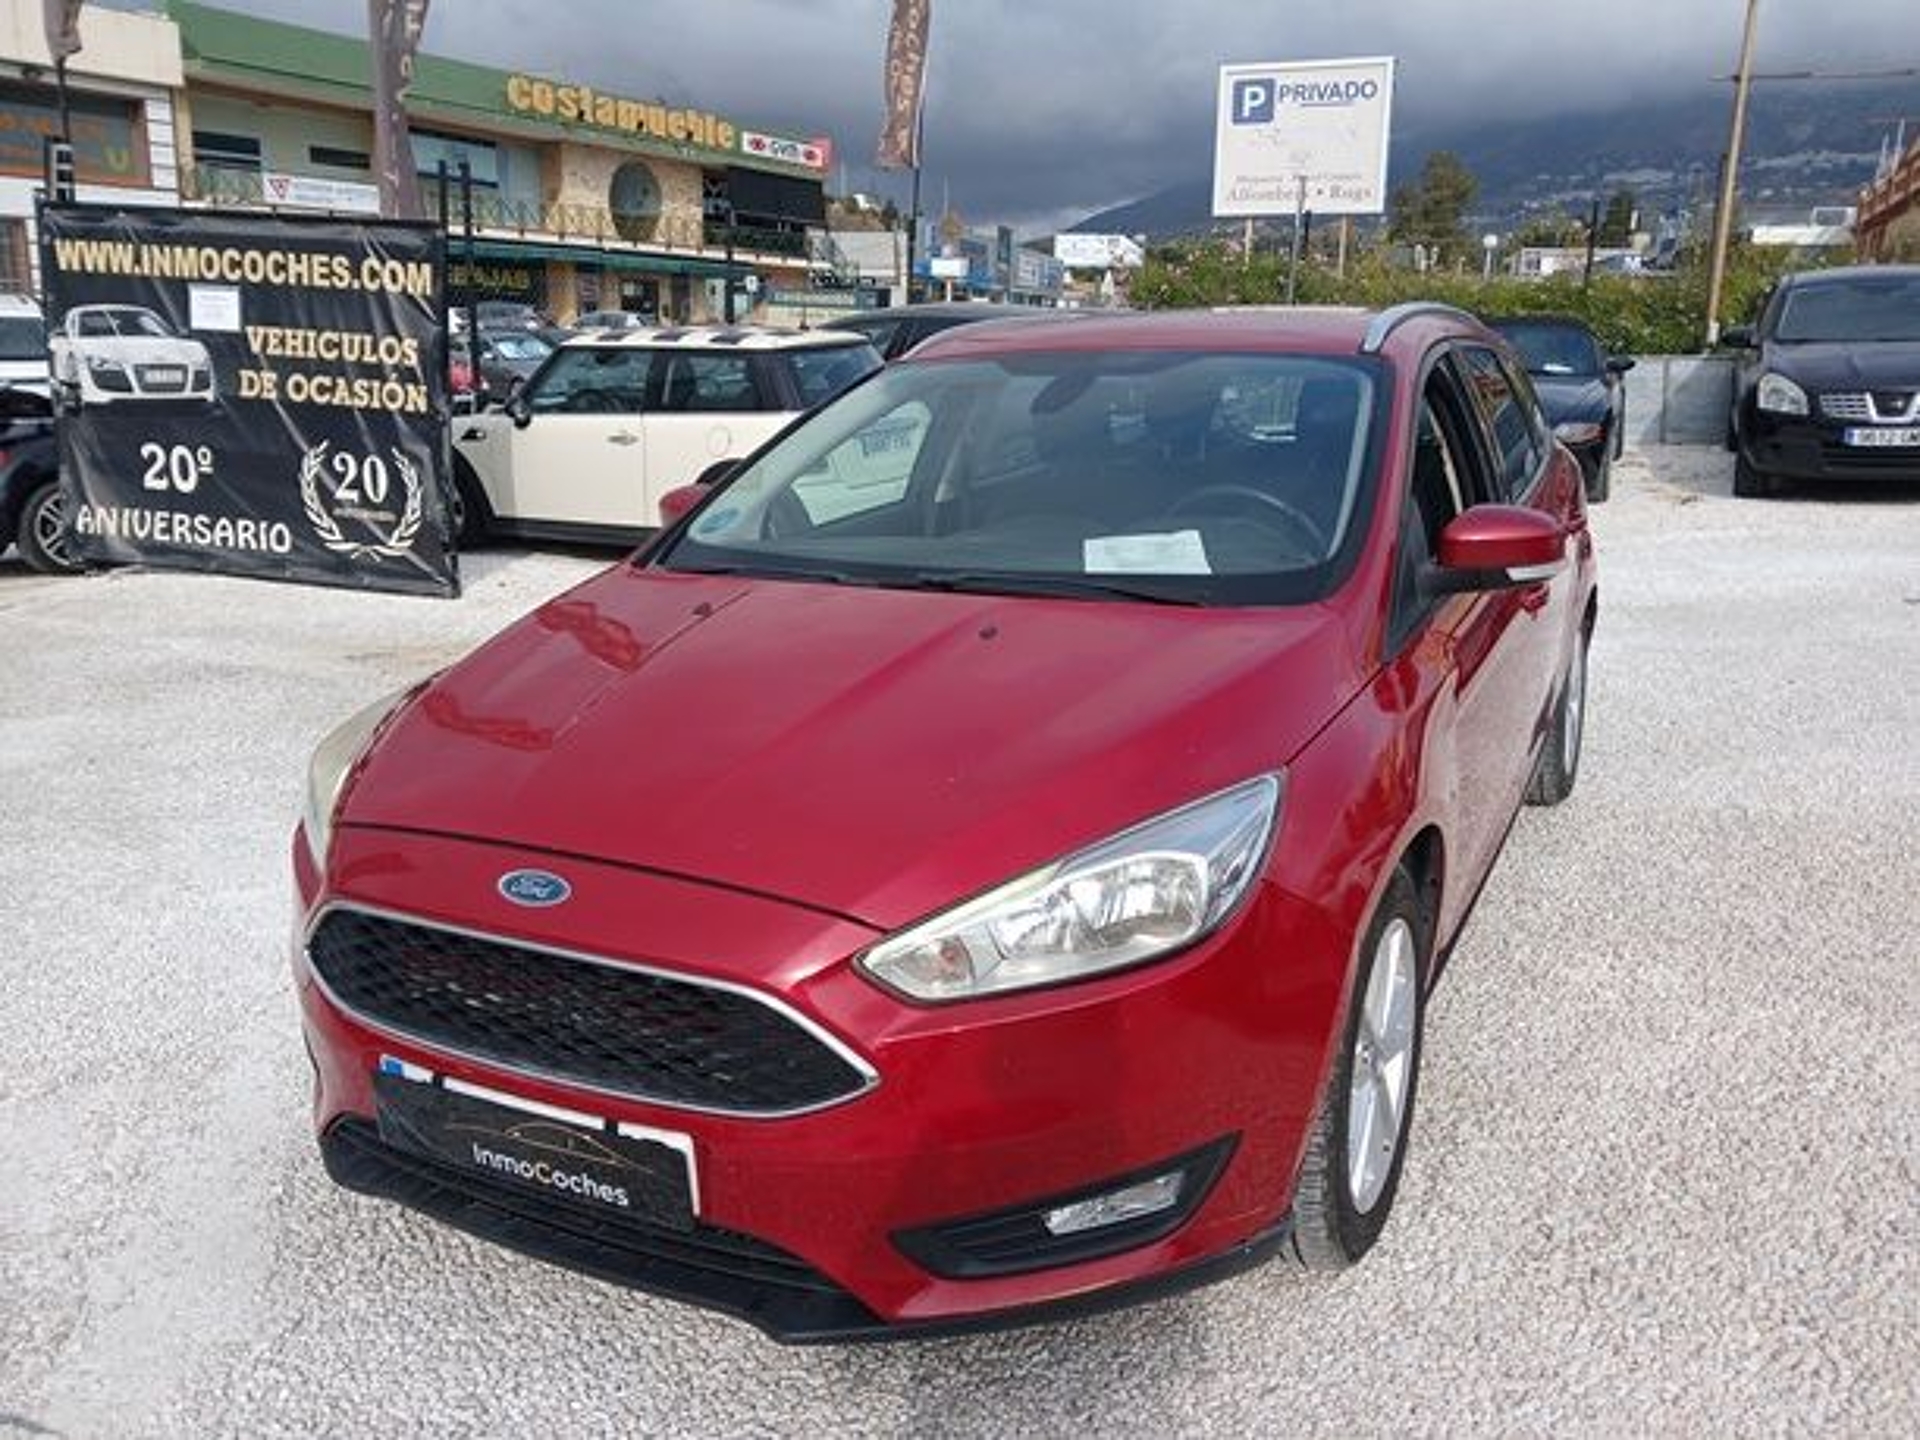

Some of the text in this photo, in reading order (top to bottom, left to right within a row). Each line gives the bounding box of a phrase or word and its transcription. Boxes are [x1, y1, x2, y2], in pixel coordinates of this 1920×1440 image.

[1279, 80, 1378, 103] PRIVADO
[55, 238, 432, 296] WWW.INMOCOCHES.COM
[246, 325, 419, 366] VEHICULOS
[239, 370, 428, 413] DE OCASIÓN
[332, 450, 390, 503] 20
[76, 503, 292, 553] ANIVERSARIO
[472, 1141, 629, 1206] InmoCoches
